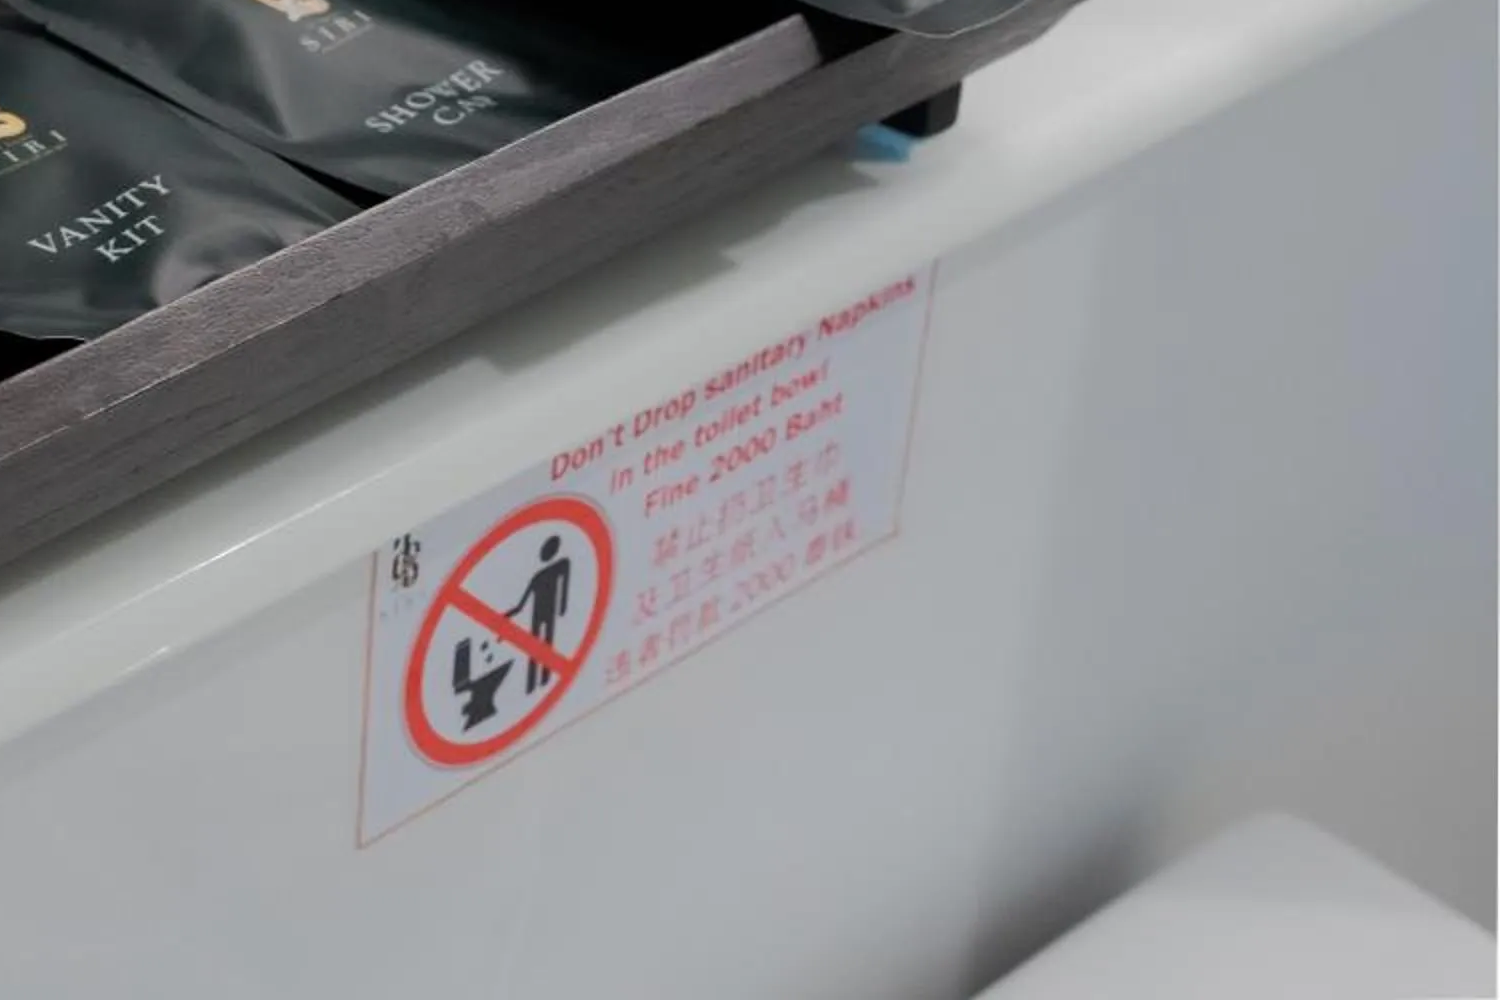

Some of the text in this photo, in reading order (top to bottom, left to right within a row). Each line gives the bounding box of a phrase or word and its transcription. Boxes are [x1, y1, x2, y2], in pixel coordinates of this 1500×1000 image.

[365, 58, 503, 134] SHOWER
[27, 174, 171, 255] VANITY
[95, 214, 165, 263] KIT
[550, 275, 916, 482] Don't Drop sanitary Napkins
[642, 438, 686, 476] the
[693, 395, 762, 449] toilet
[770, 357, 832, 408] bowl
[643, 391, 844, 519] Fine 2000 Baht
